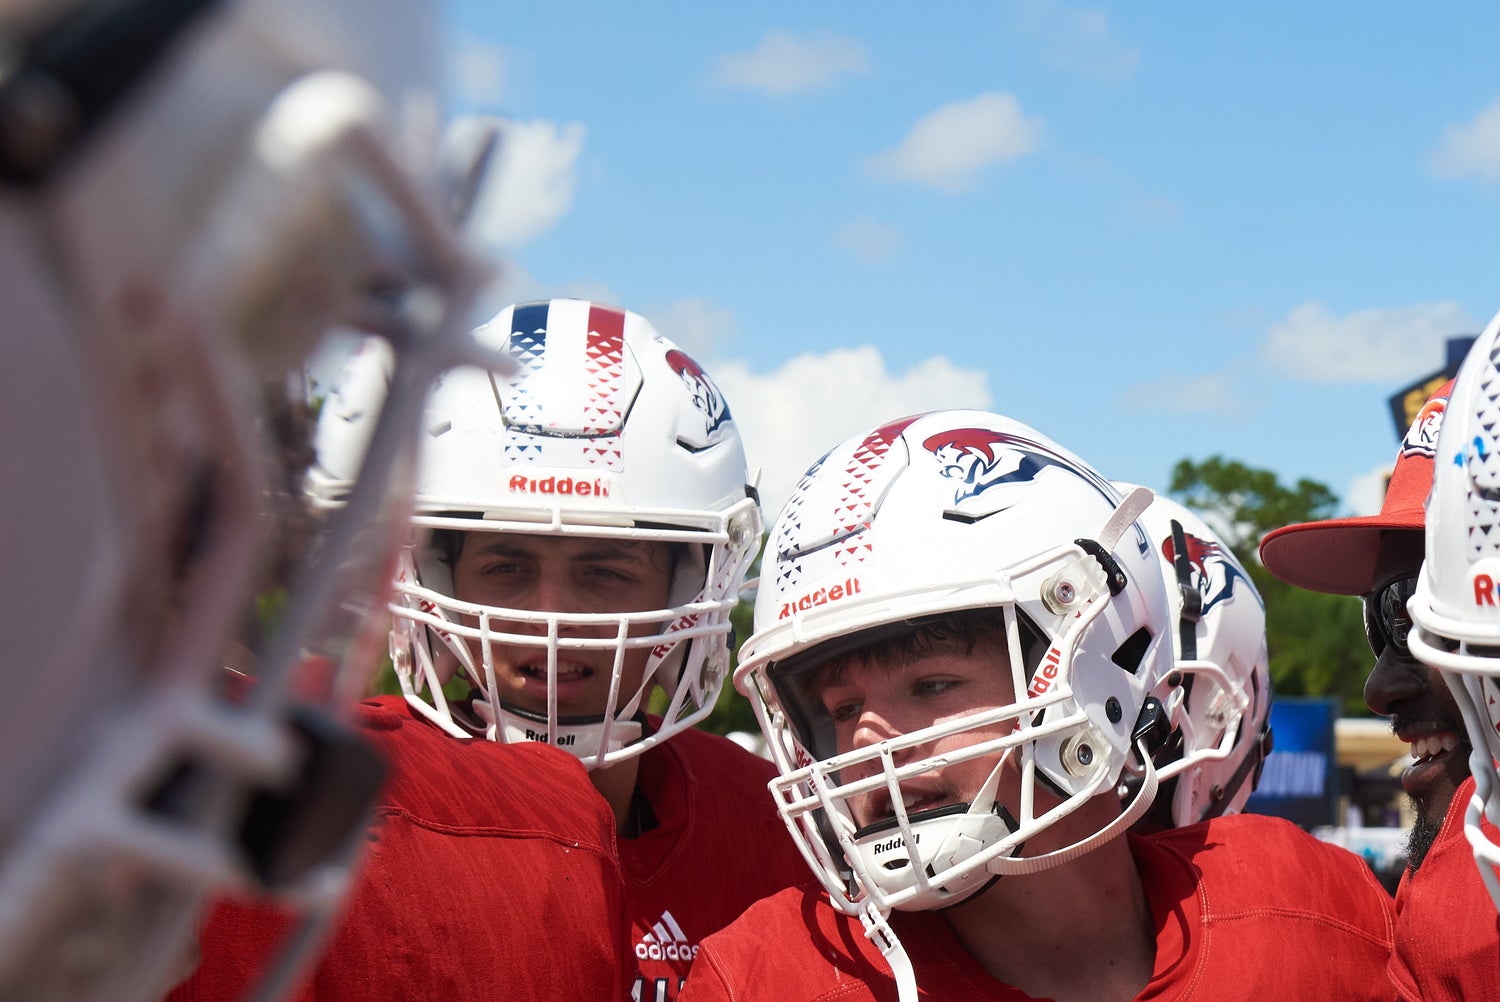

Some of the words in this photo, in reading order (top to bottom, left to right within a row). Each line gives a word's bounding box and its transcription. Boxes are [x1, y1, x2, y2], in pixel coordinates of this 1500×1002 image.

[508, 474, 610, 498] Riddell
[778, 577, 862, 621] Riddell
[526, 728, 577, 746] Ridell
